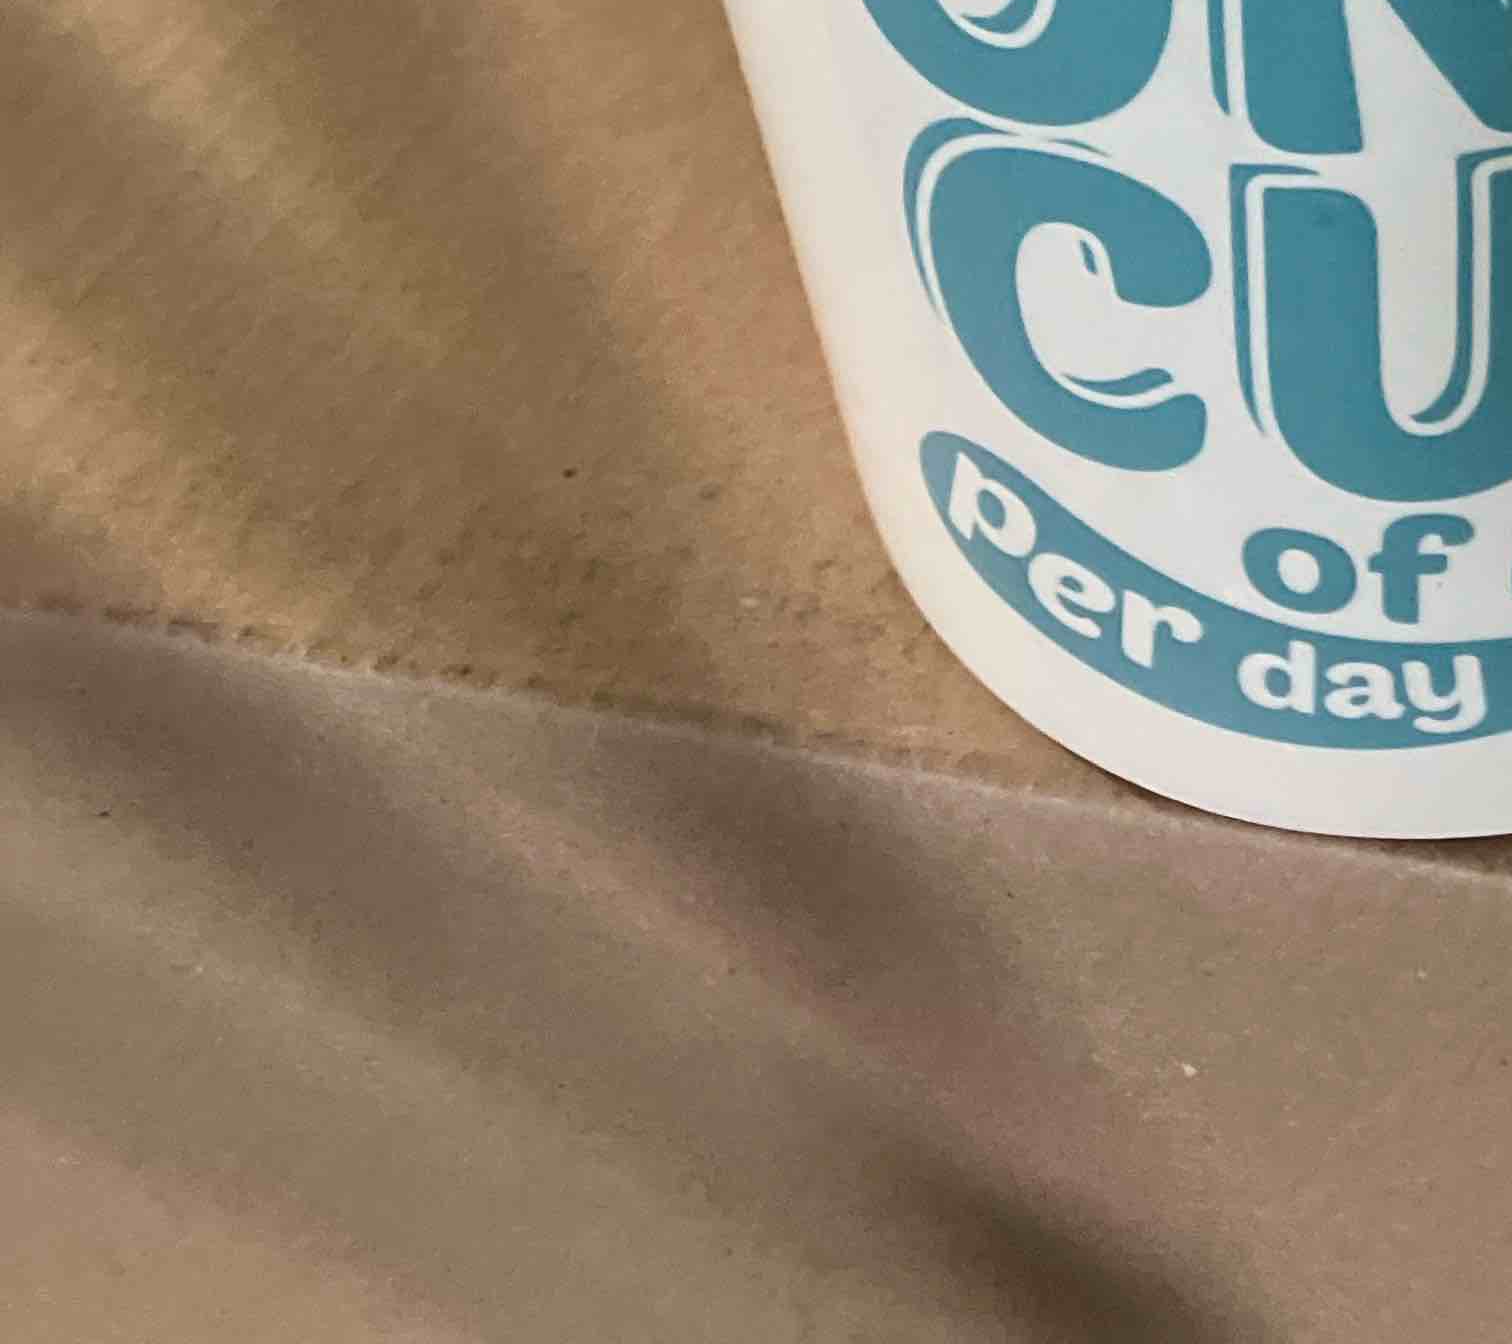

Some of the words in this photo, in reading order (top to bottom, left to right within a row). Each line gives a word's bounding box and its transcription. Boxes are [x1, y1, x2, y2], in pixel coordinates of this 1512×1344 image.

[947, 449, 1202, 670] per
[1236, 640, 1489, 734] day
[1240, 514, 1475, 624] of
